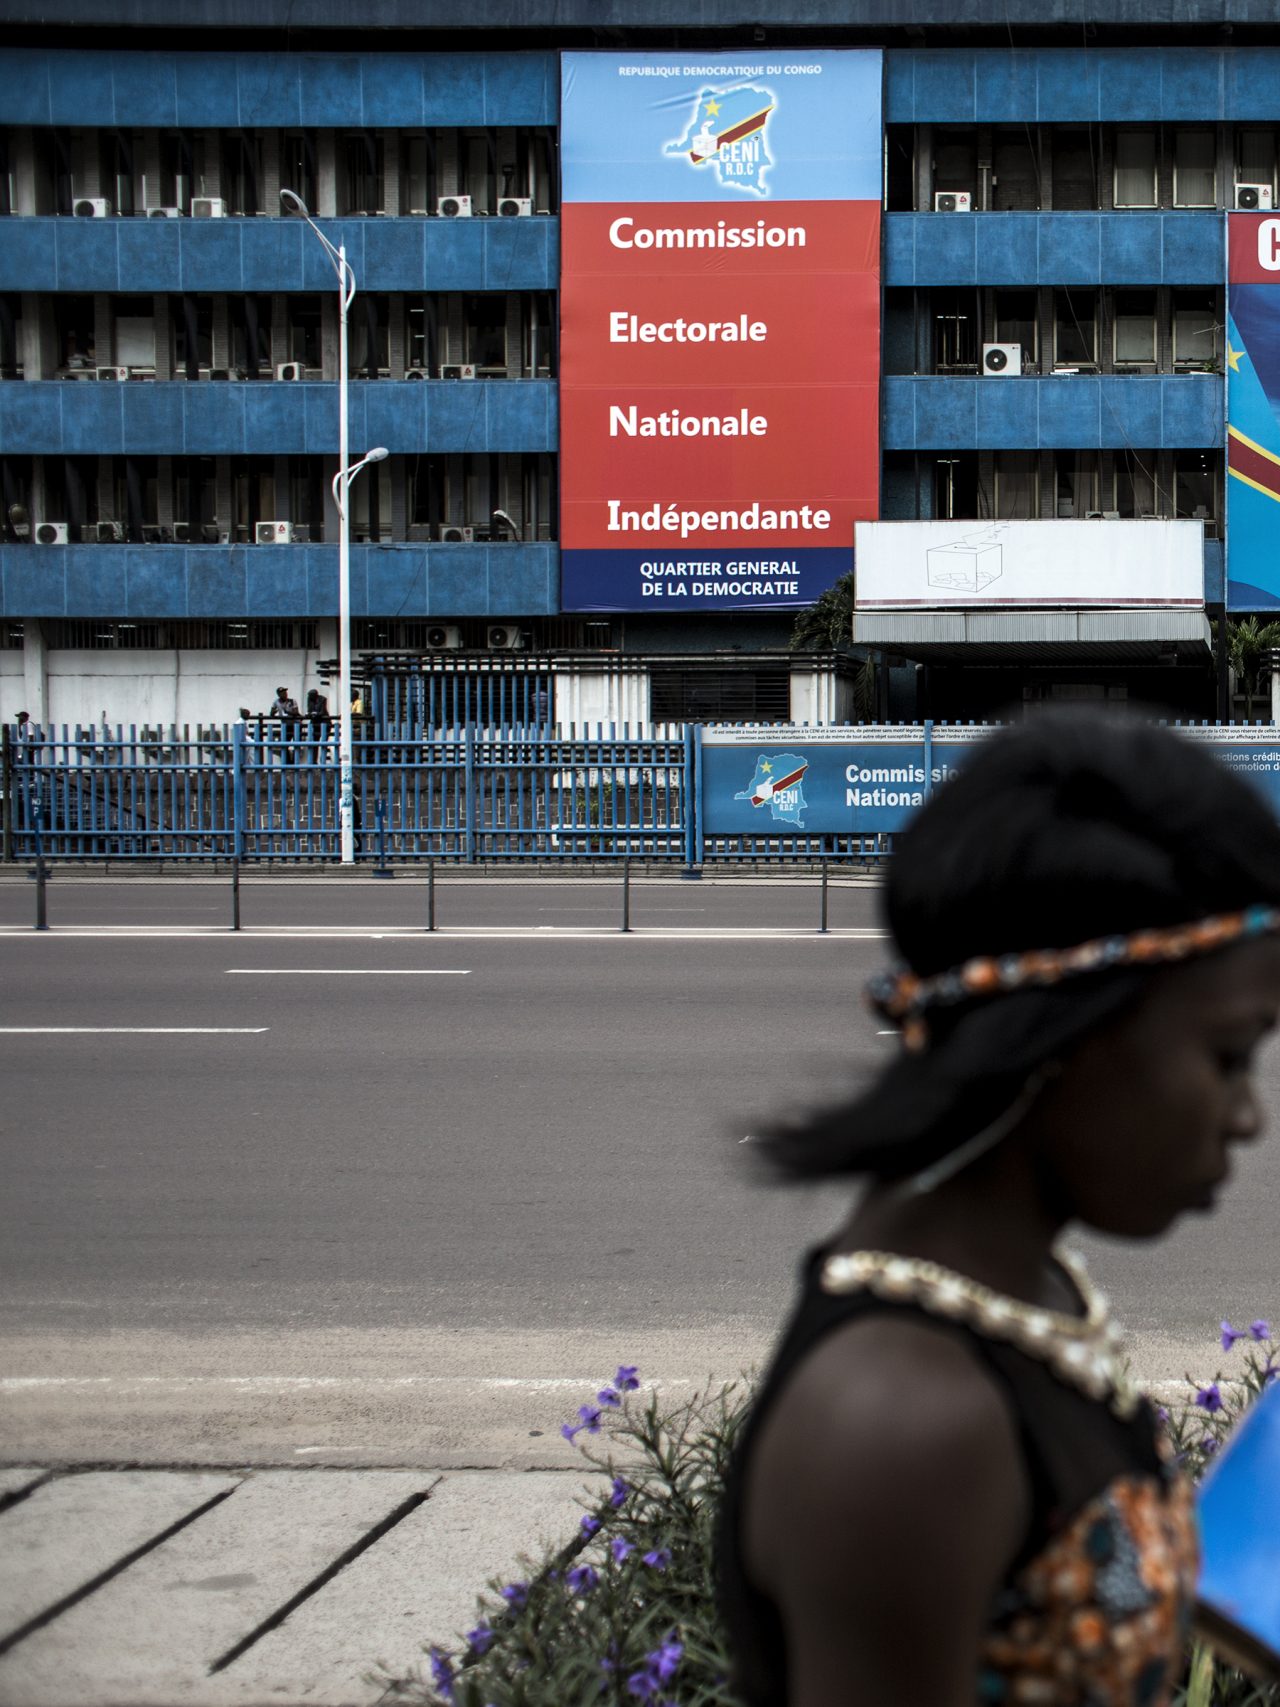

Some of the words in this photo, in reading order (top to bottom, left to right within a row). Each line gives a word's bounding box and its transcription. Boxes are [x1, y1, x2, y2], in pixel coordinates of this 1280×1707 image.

[619, 66, 681, 76] REPUBLIQUE
[683, 65, 764, 76] DEMOCRATIQUE
[766, 65, 782, 75] DU
[784, 64, 822, 75] CONGO
[718, 141, 759, 163] CENI
[725, 163, 754, 176] R.D.C
[608, 217, 807, 249] Commission
[608, 311, 767, 343] Electorale
[608, 405, 768, 438] Nationale
[607, 500, 831, 538] Indépendante
[639, 562, 722, 578] QUARTIER
[725, 560, 801, 576] GENERAL
[641, 581, 664, 597] DE
[667, 581, 687, 597] LA
[690, 580, 799, 596] DEMOCRATIE
[845, 764, 965, 783] Commissio
[773, 790, 798, 804] CENI
[846, 789, 934, 807] Nationa
